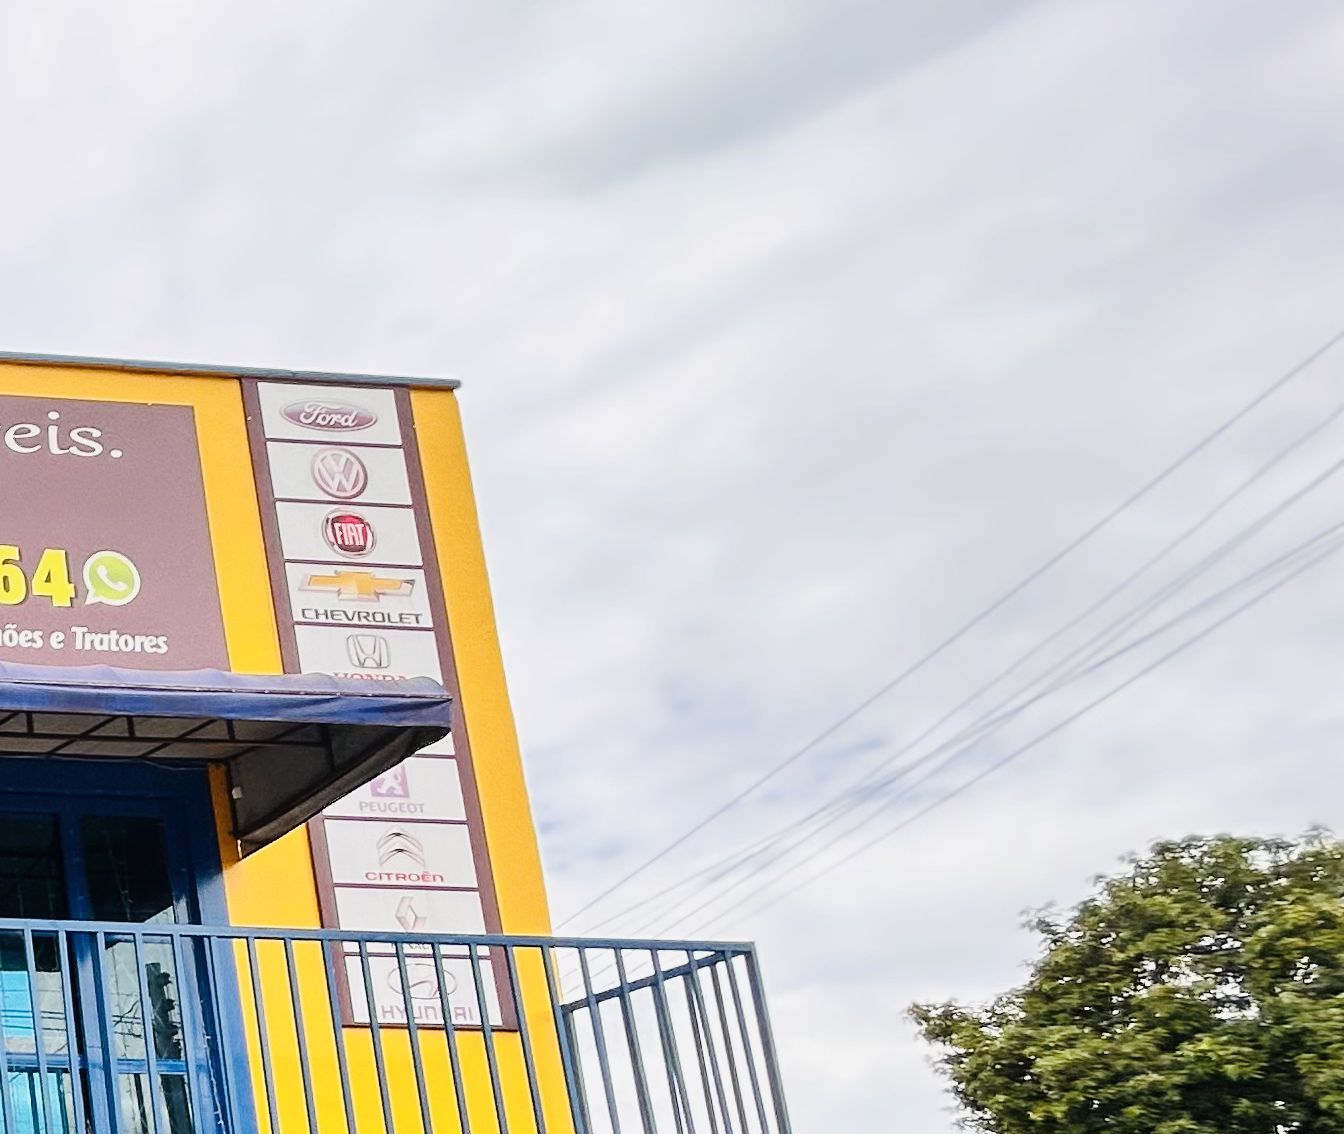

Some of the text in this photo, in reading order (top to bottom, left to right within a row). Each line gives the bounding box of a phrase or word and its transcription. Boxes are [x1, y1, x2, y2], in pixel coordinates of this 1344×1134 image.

[300, 403, 357, 428] Ford
[334, 522, 365, 546] FIAT
[301, 607, 423, 625] CHEVROLET
[49, 630, 66, 650] e
[70, 626, 169, 655] Tratores
[359, 801, 426, 815] PEUGEOT
[381, 1005, 474, 1022] HYUNAI
